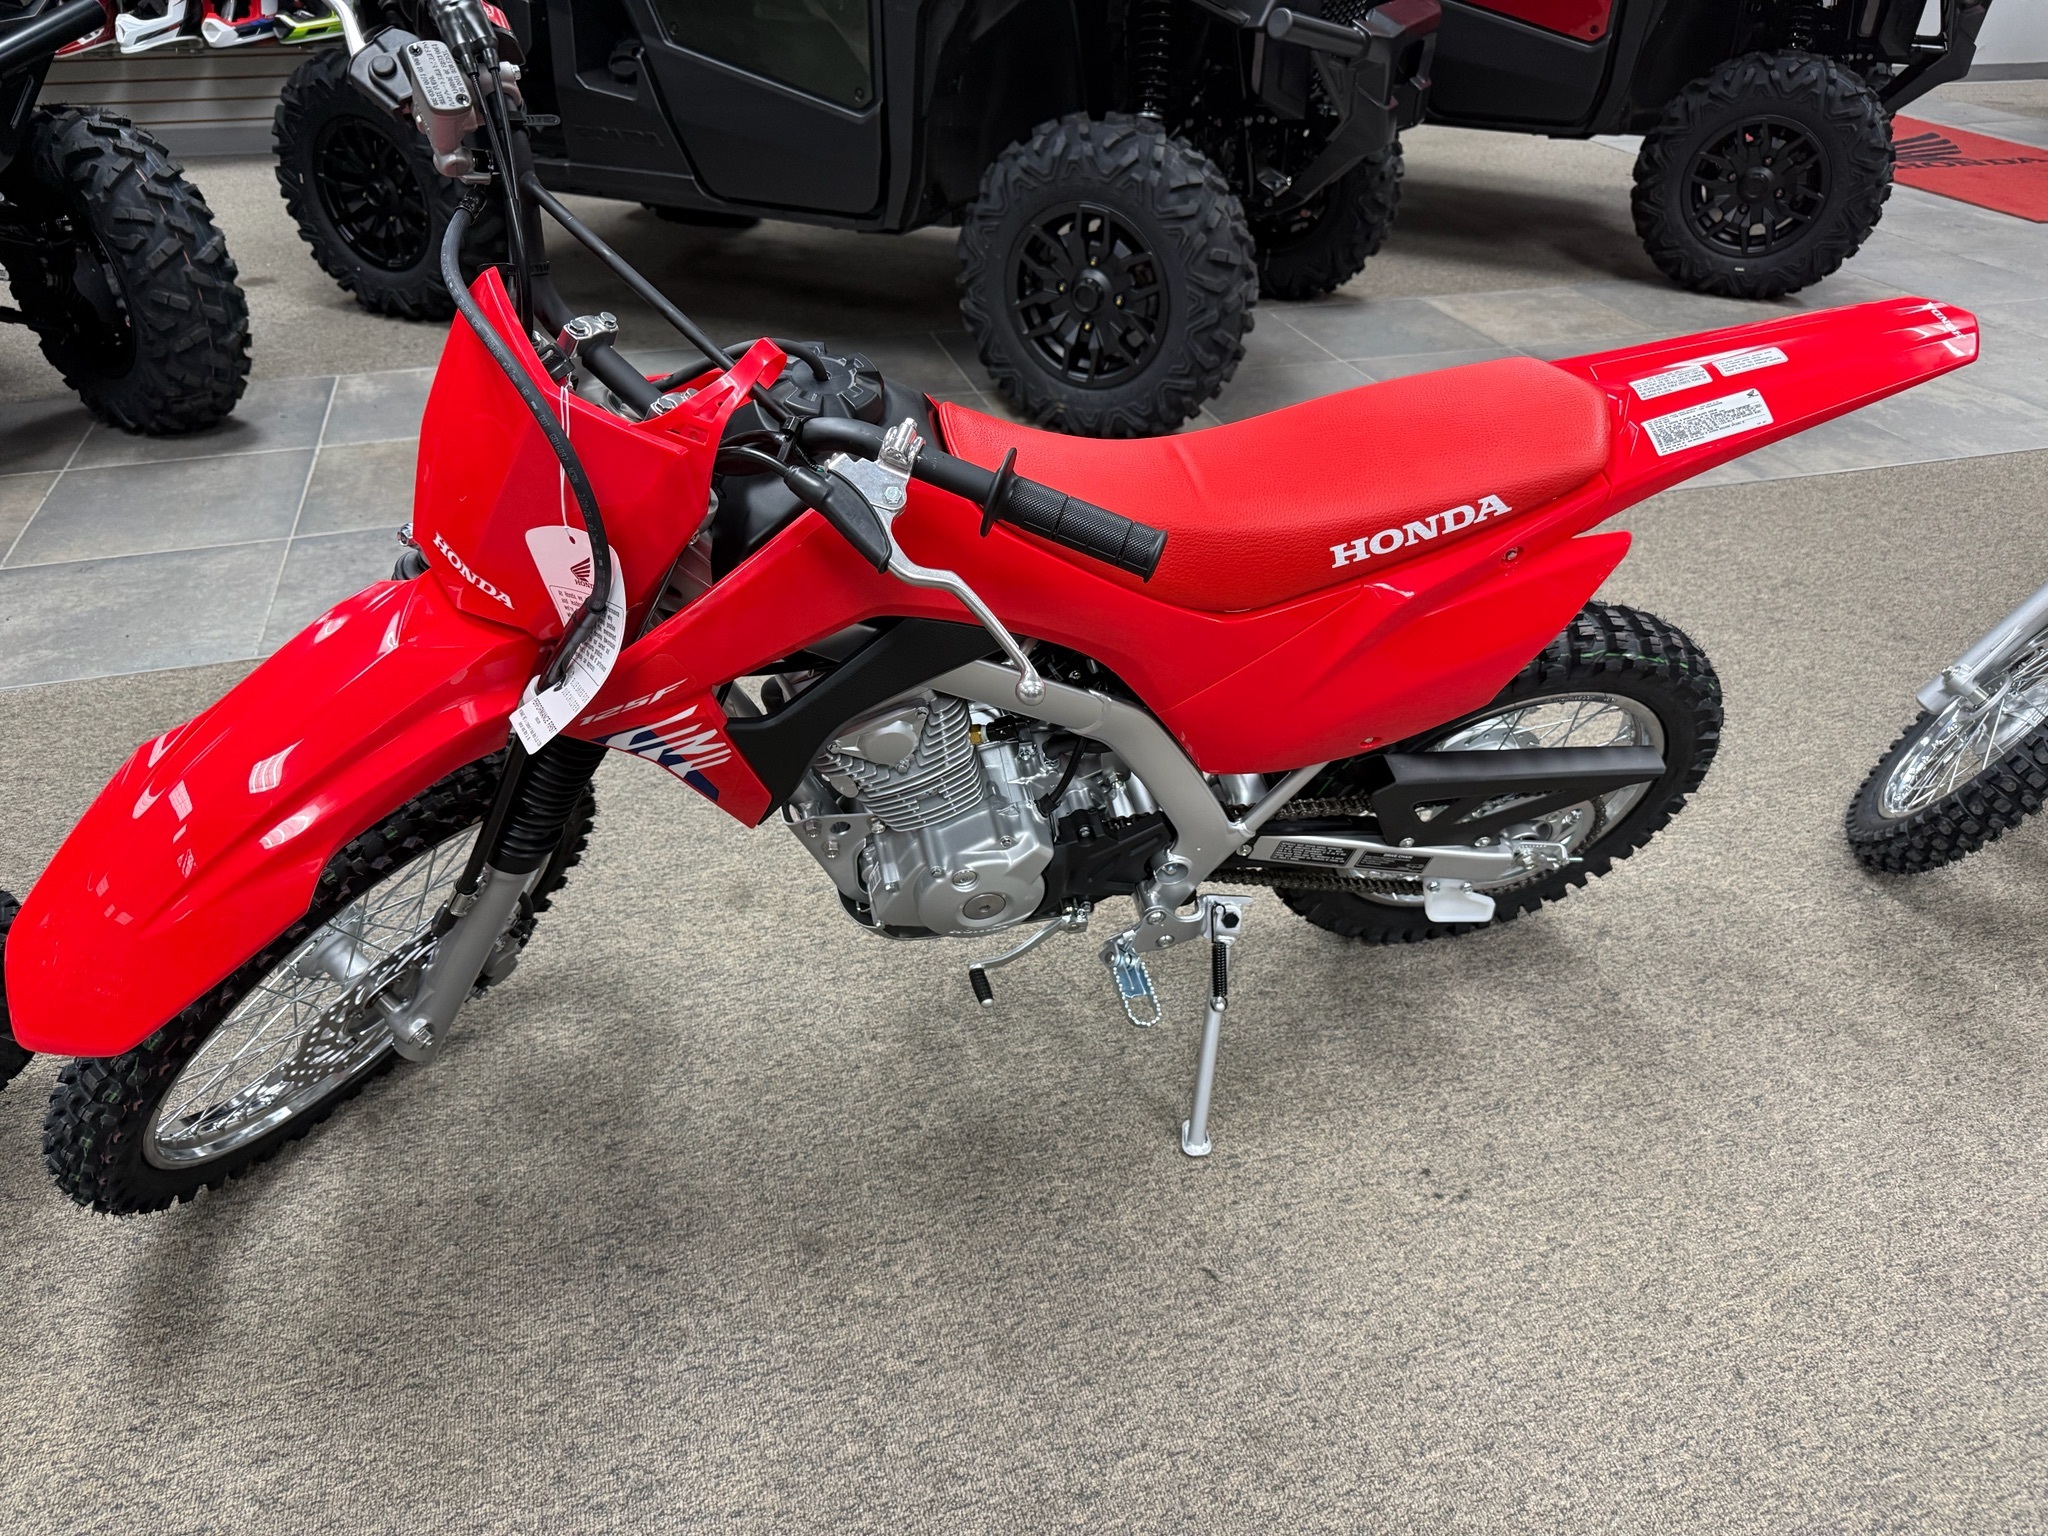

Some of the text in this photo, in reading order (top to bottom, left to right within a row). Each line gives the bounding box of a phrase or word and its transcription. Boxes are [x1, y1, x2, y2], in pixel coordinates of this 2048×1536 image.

[1329, 493, 1512, 569] HONDA
[432, 531, 515, 611] HONDA
[579, 677, 688, 727] 125F
